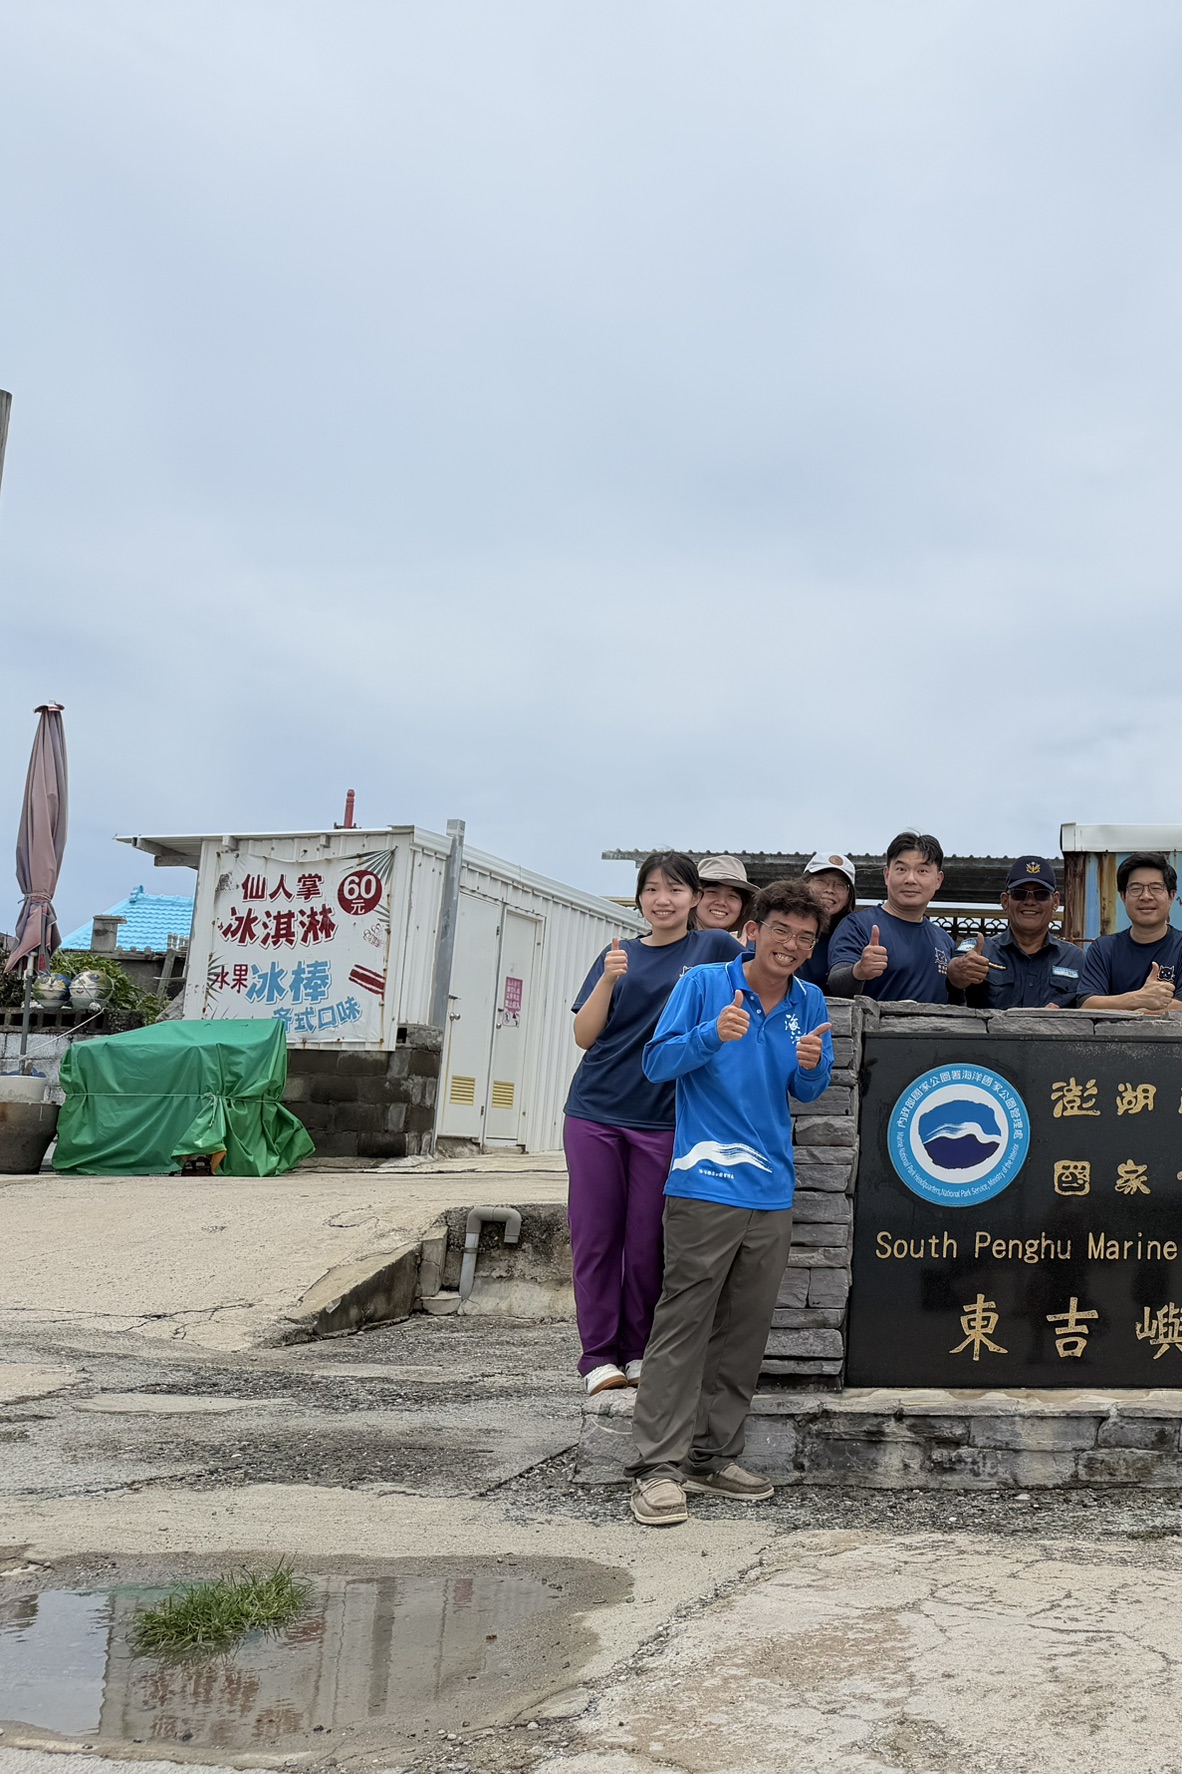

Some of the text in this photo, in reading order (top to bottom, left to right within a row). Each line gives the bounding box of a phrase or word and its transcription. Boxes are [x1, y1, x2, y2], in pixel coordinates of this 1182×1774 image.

[241, 873, 323, 900] 仙人掌
[343, 875, 377, 900] 60
[350, 900, 366, 915] 元
[221, 904, 337, 947] 冰淇淋
[210, 960, 331, 1003] 水果 冰棒
[897, 1069, 1024, 1140] 內政部國家公園署海洋國家公園管理處
[960, 1188, 972, 1198] Park
[971, 1183, 991, 1196] Service,
[987, 1170, 1006, 1187] Ministry
[875, 1230, 958, 1260] South
[974, 1231, 1072, 1264] Penghu
[1088, 1231, 1179, 1261] Marine
